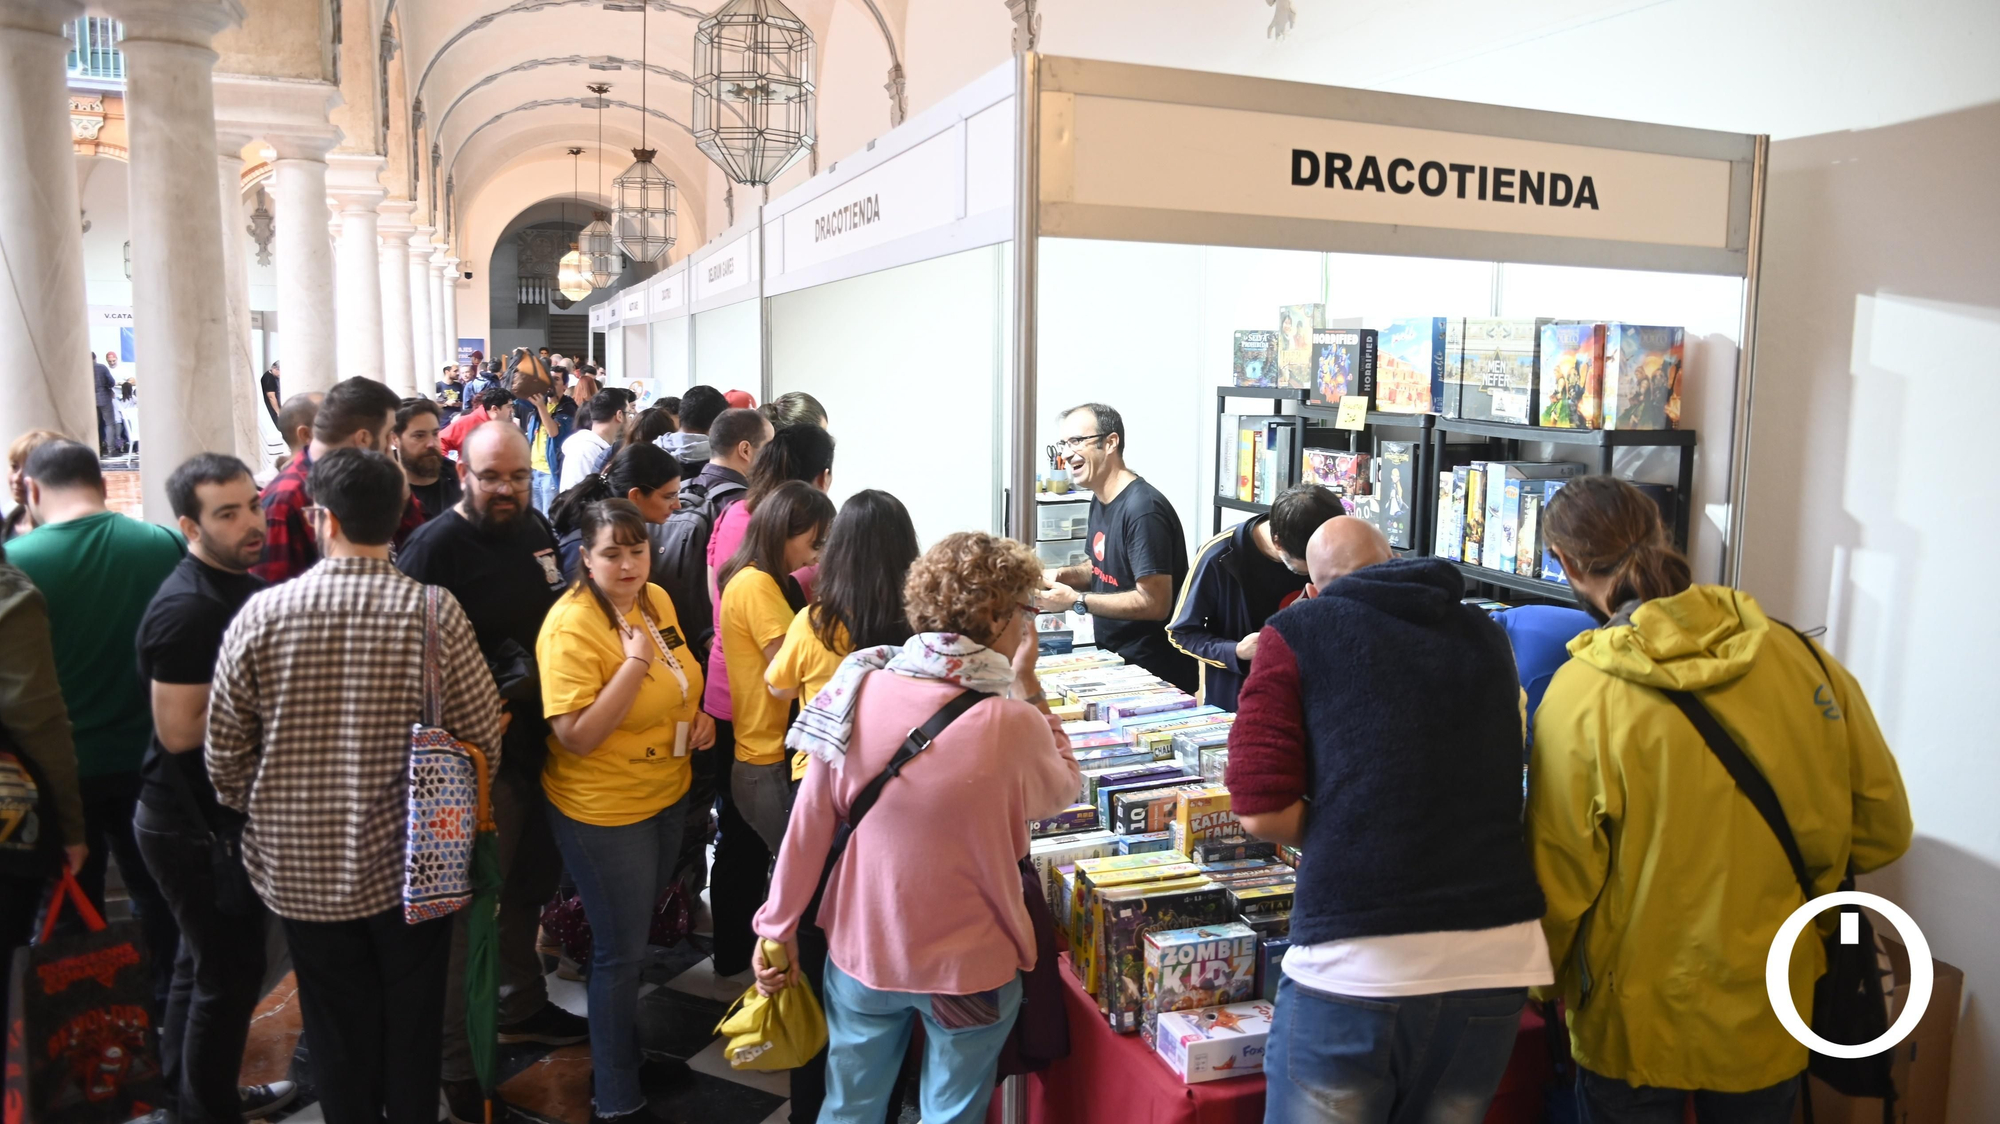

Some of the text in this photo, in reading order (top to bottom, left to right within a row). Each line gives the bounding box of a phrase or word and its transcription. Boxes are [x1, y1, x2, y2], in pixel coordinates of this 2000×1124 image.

[1291, 148, 1600, 210] DRACOTIENDA
[815, 193, 881, 243] DRACOTIENDA
[1313, 333, 1359, 345] HORRIFIED
[1364, 335, 1373, 391] HORRIFIED
[1487, 360, 1506, 373] MEN
[1482, 373, 1511, 387] NEFER
[1131, 808, 1146, 831] 10
[1214, 868, 1271, 879] PATCHWORK
[1163, 937, 1253, 965] ZOMBIE
[1161, 955, 1253, 994] KIDZ
